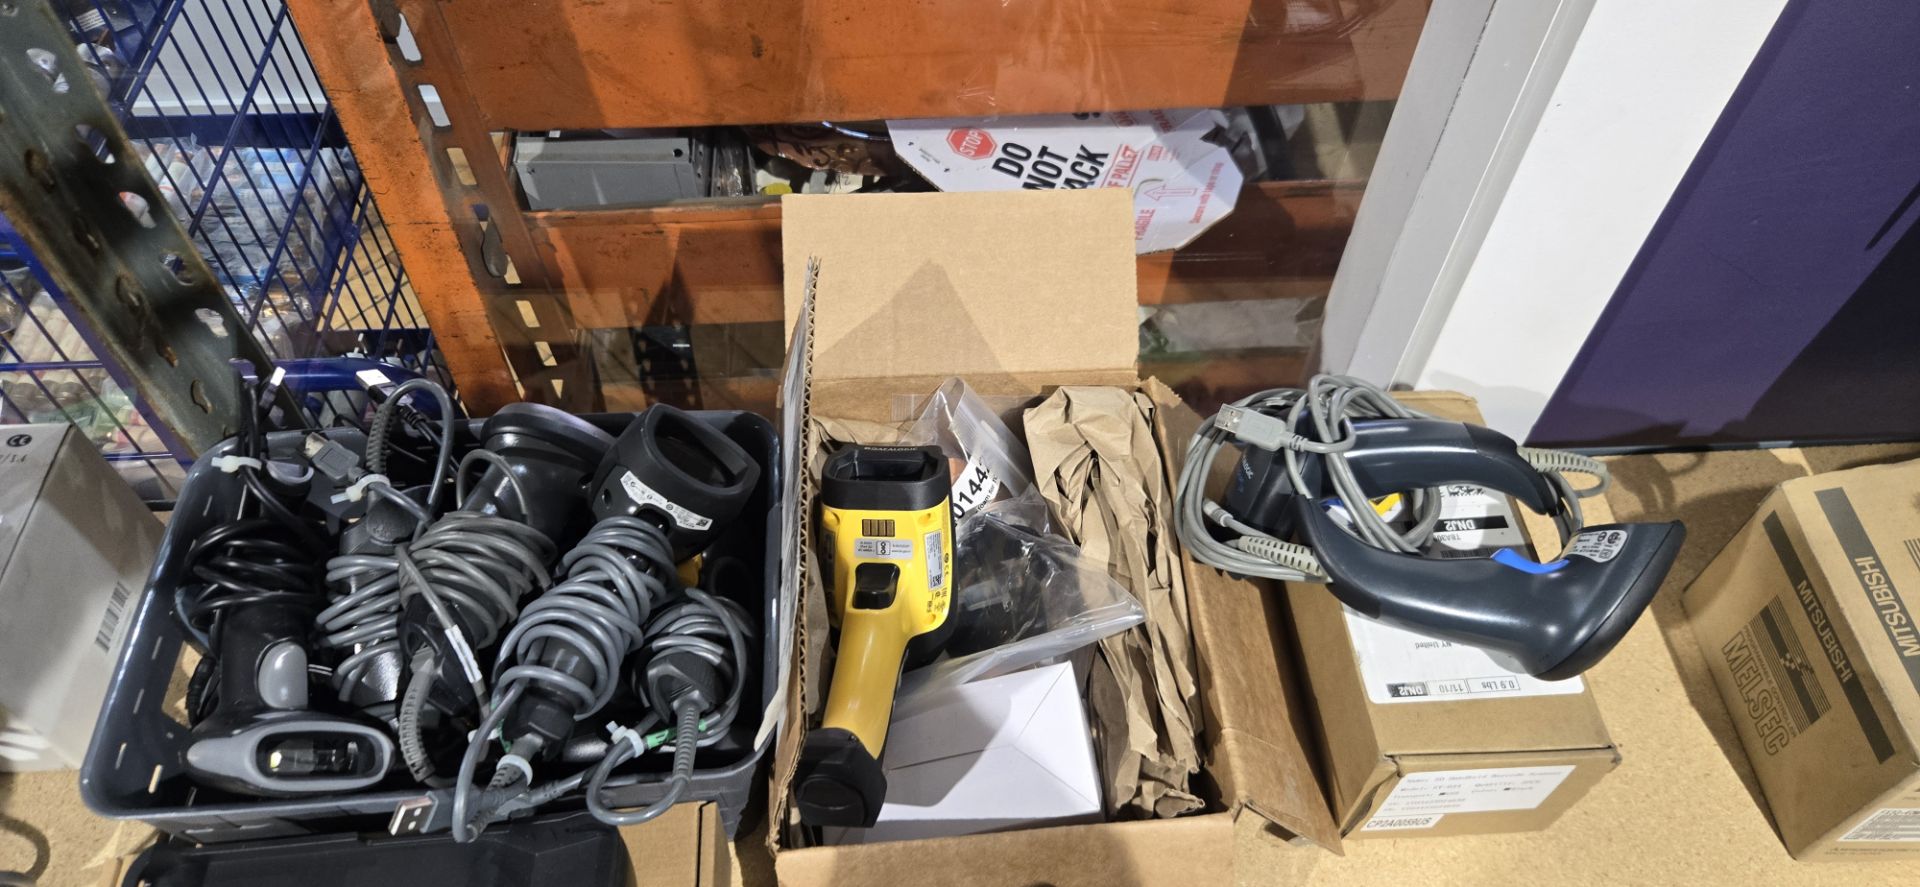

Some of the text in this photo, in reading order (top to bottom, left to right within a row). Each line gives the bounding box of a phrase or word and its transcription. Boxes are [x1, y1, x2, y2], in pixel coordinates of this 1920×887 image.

[959, 128, 982, 157] STOP
[991, 142, 1032, 178] DO
[1022, 145, 1068, 189] NOT
[1061, 144, 1109, 189] ACK
[1443, 519, 1476, 532] DNJ2
[1854, 556, 1920, 657] MITSUBISHI
[1415, 641, 1440, 650] United
[1797, 579, 1854, 683] MITSUBISHI
[1398, 685, 1424, 697] DNJ2
[1480, 681, 1500, 691] Lbs
[1721, 631, 1790, 756] MELSEC
